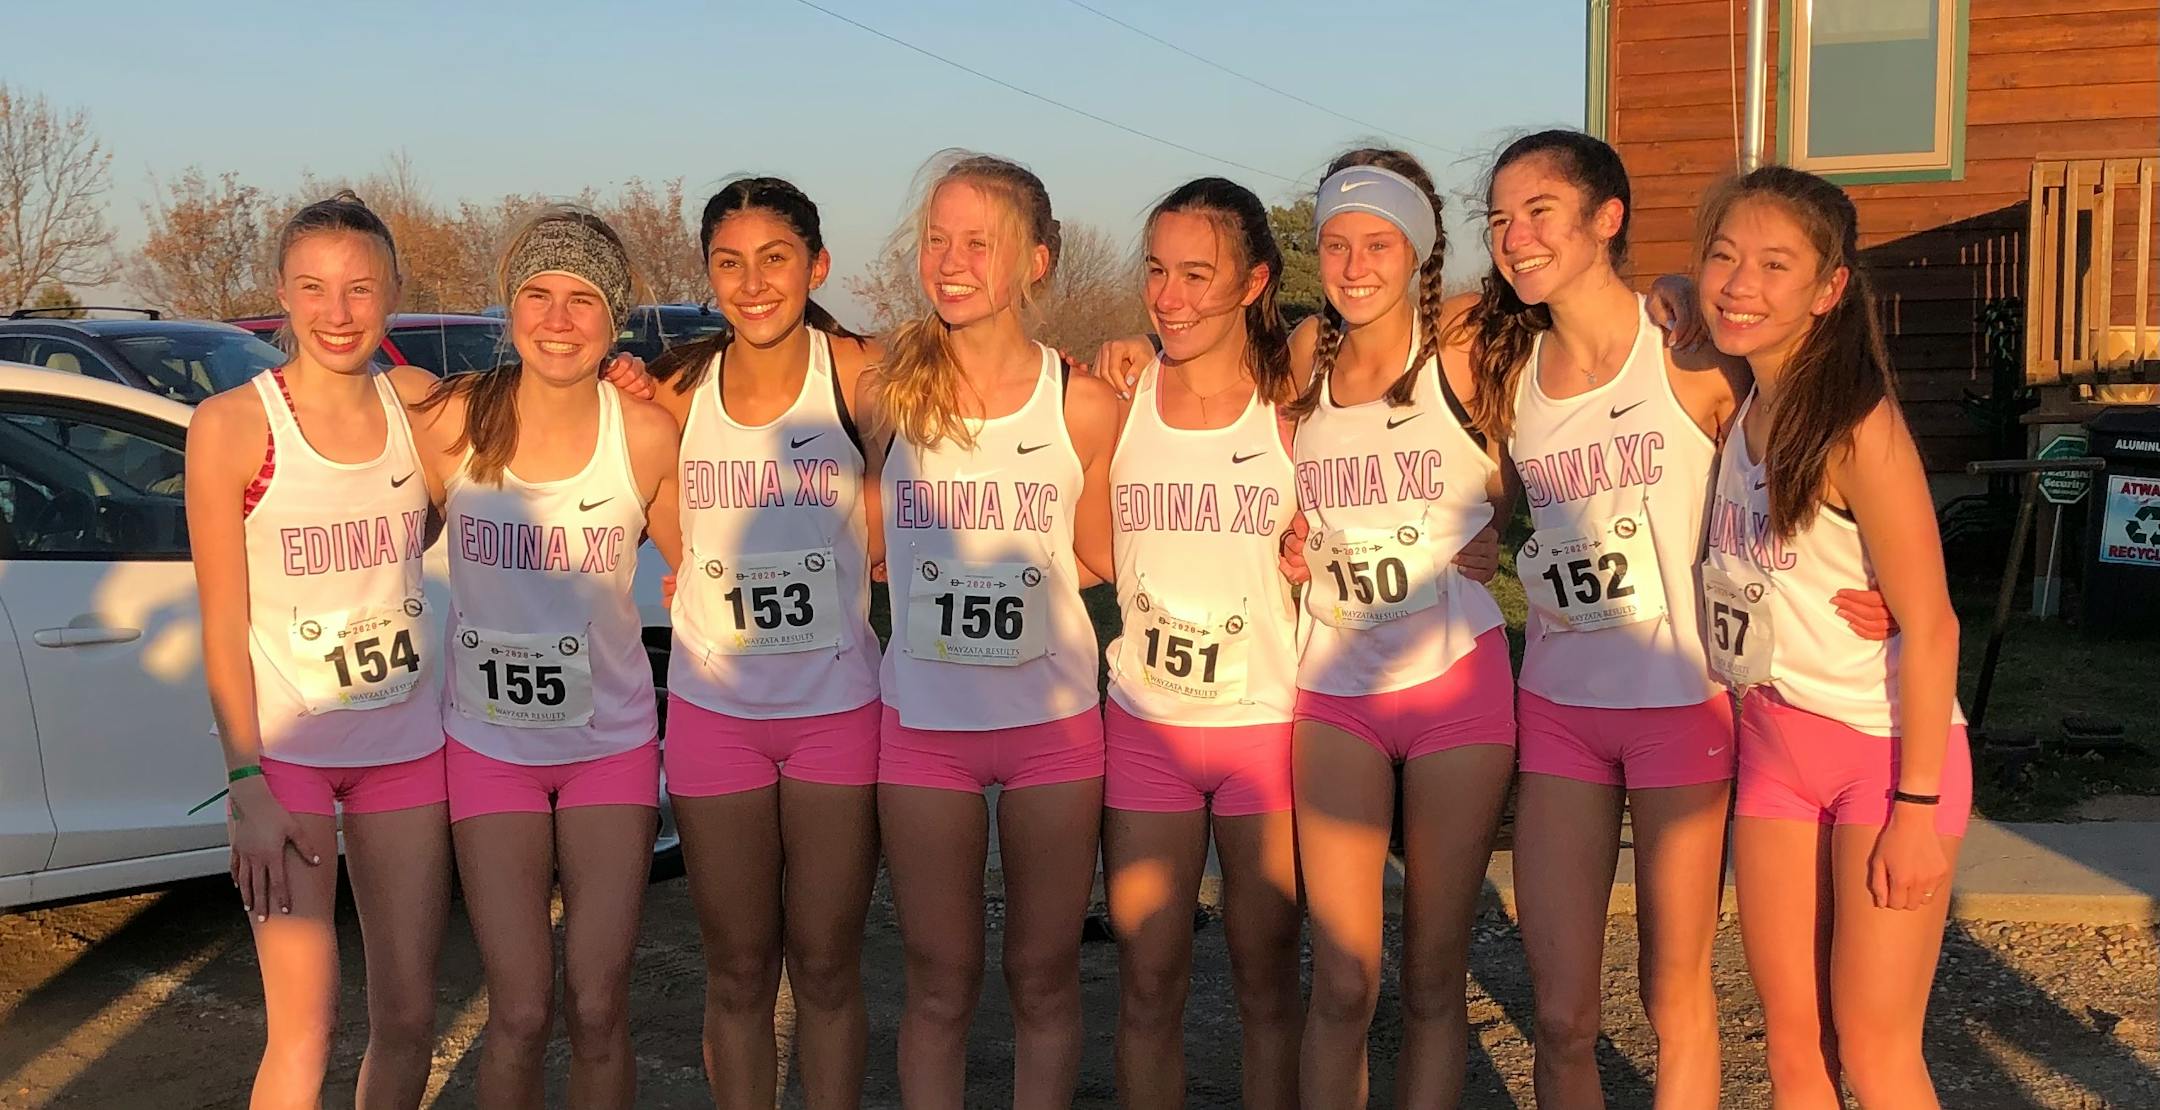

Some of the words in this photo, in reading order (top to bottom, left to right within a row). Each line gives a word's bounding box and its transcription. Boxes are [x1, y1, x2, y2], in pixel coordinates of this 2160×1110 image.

[684, 460, 785, 510] EDINA
[793, 458, 840, 508] XC
[1297, 454, 1388, 512] EDINA
[1394, 449, 1444, 502] XC
[1516, 442, 1612, 508] EDINA
[1614, 431, 1664, 488] XC
[2044, 478, 2085, 491] Security
[896, 480, 1004, 530] EDINA
[1013, 482, 1058, 533] XC
[1116, 483, 1221, 532] EDINA
[1231, 484, 1279, 536] XC
[280, 516, 398, 576] EDINA
[460, 514, 570, 572] EDINA
[579, 526, 625, 573] XC
[1751, 511, 1797, 571] XC
[751, 571, 776, 580] 2020
[967, 580, 992, 589] 2020
[1326, 557, 1409, 605] 150
[1542, 552, 1636, 608] 152
[353, 622, 379, 635] 2020
[724, 583, 814, 630] 153
[935, 592, 1024, 641] 156
[1172, 622, 1197, 634] 2020
[1342, 610, 1374, 620] WAYZATA
[1568, 612, 1602, 623] WAYZATA
[1602, 605, 1638, 619] RESULTS
[1714, 601, 1750, 656] 57
[324, 629, 421, 688] 154
[744, 636, 779, 645] WAYZATA
[781, 632, 814, 643] RESULTS
[946, 644, 984, 655] WAYZATA
[985, 647, 1020, 656] RESULTS
[1144, 627, 1220, 683] 151
[350, 690, 389, 702] WAYZATA
[478, 659, 566, 706] 155
[1150, 674, 1183, 692] WAYZATA
[1184, 685, 1218, 697] RESULTS
[495, 707, 530, 719] WAYZATA
[531, 711, 566, 720] RESULTS
